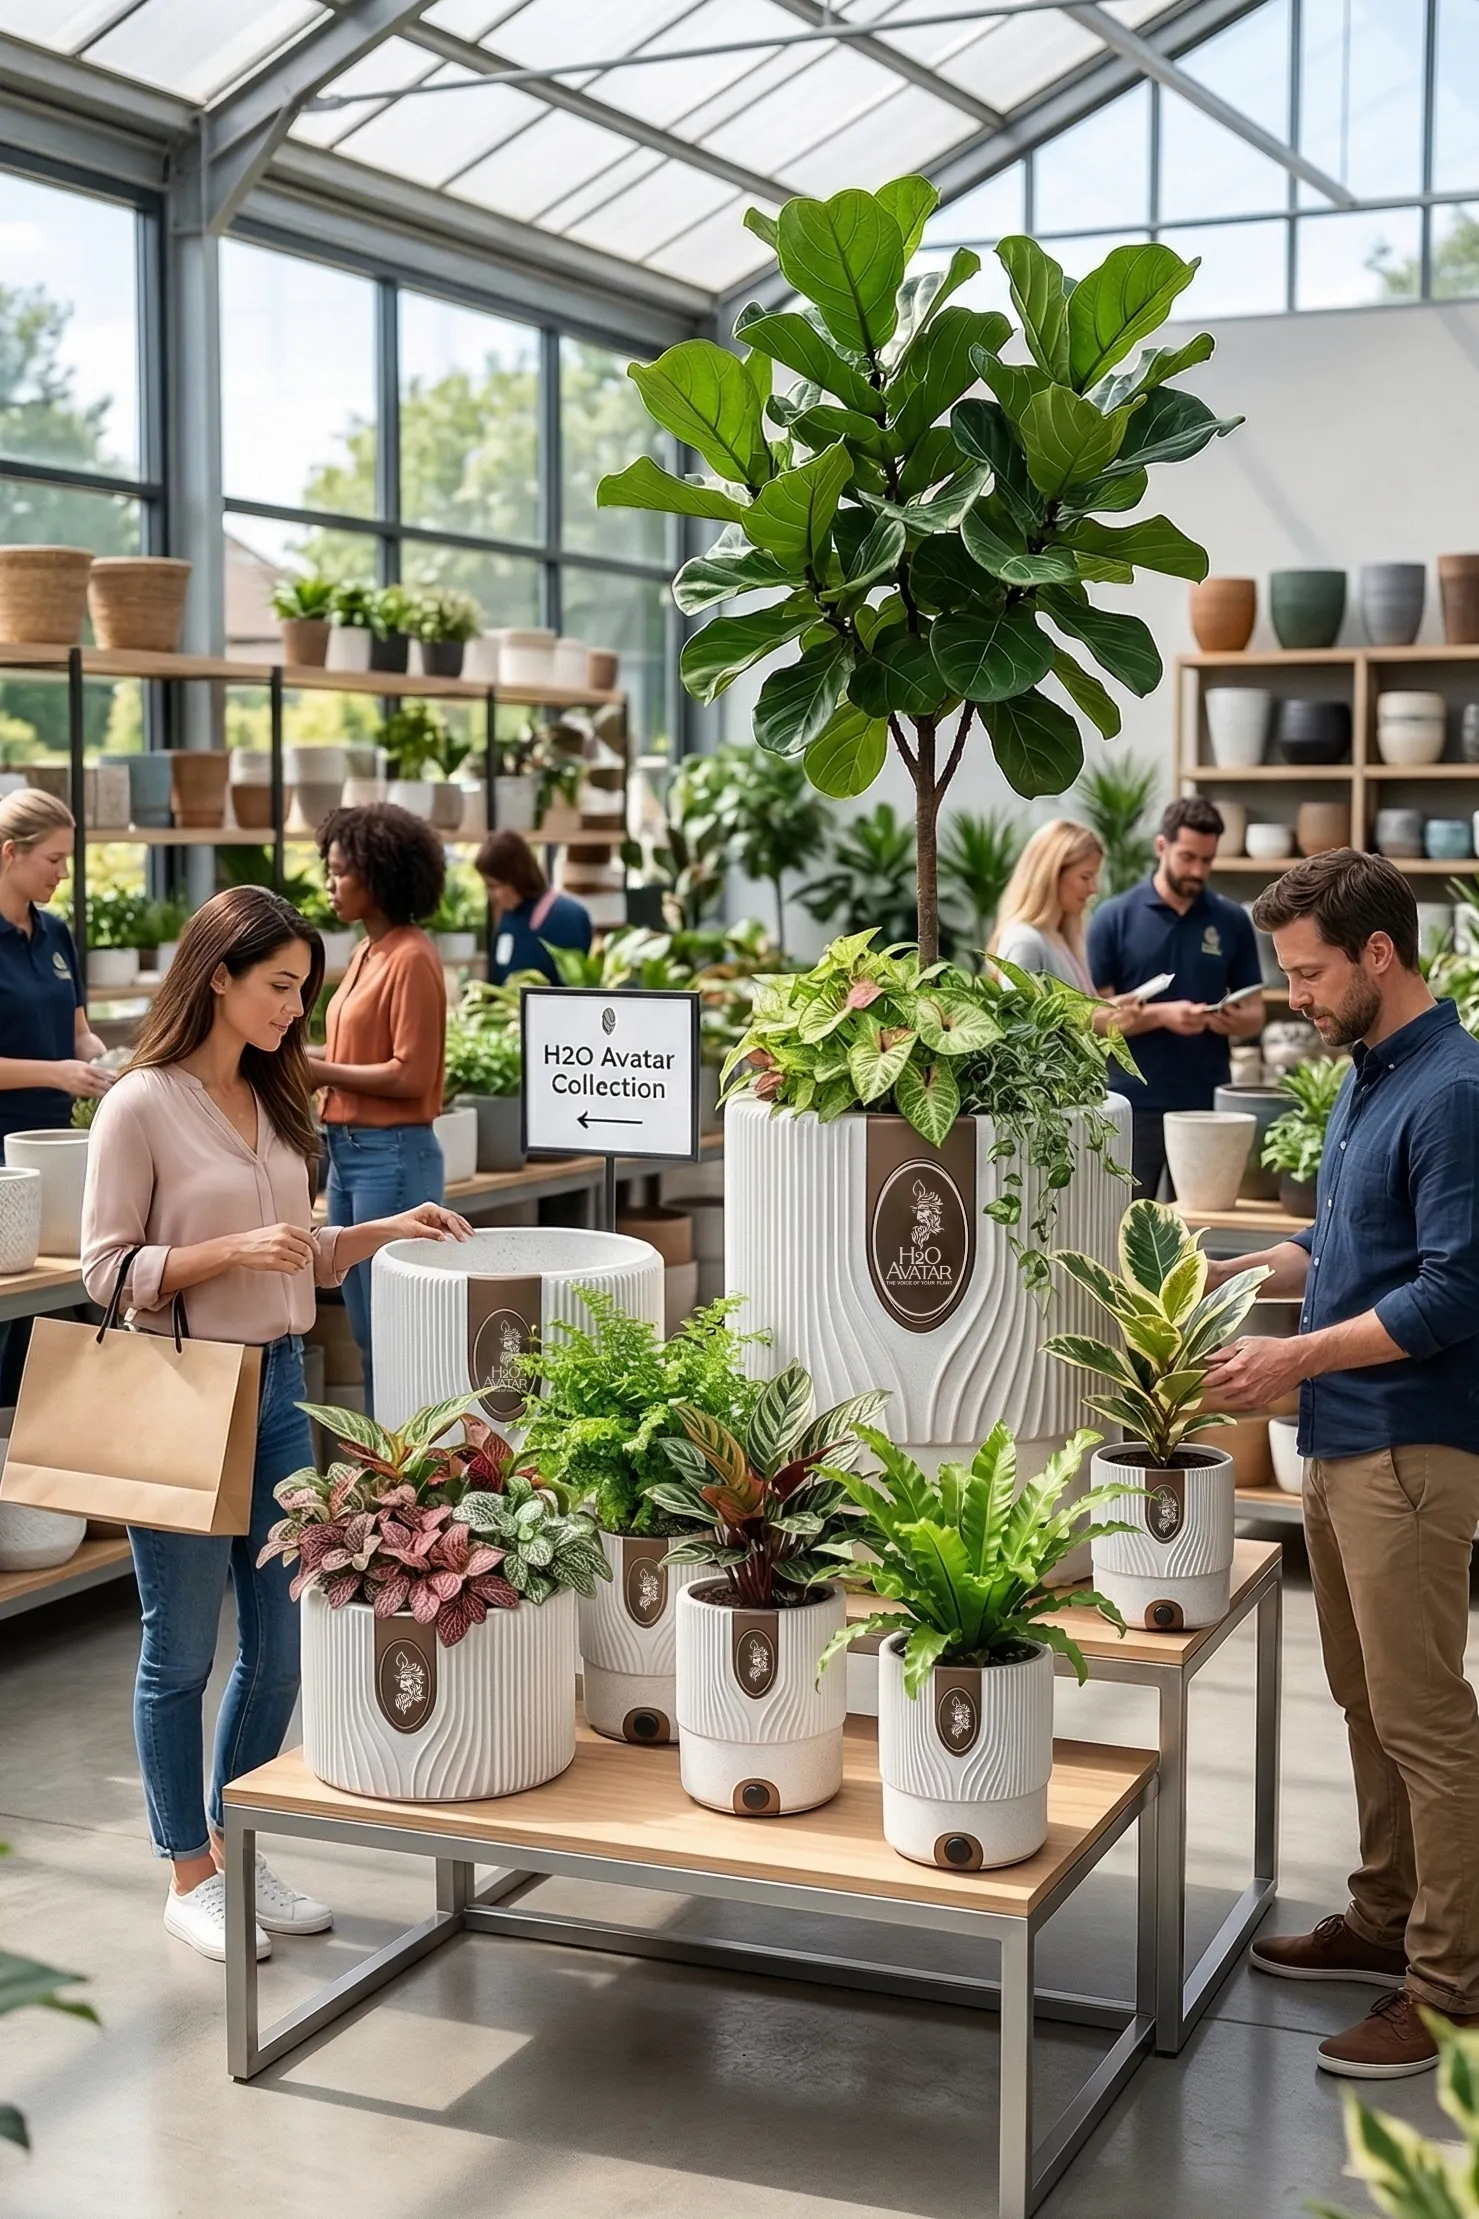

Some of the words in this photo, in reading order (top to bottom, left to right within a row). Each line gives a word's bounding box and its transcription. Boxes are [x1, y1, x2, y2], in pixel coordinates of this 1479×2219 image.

[544, 1044, 594, 1066] H2O
[600, 1046, 675, 1070] Avatar
[552, 1073, 665, 1099] Collection
[899, 1246, 941, 1265] H2O
[886, 1261, 952, 1280] AVATAR
[491, 1365, 520, 1379] H2O
[483, 1375, 527, 1389] AVATAR
